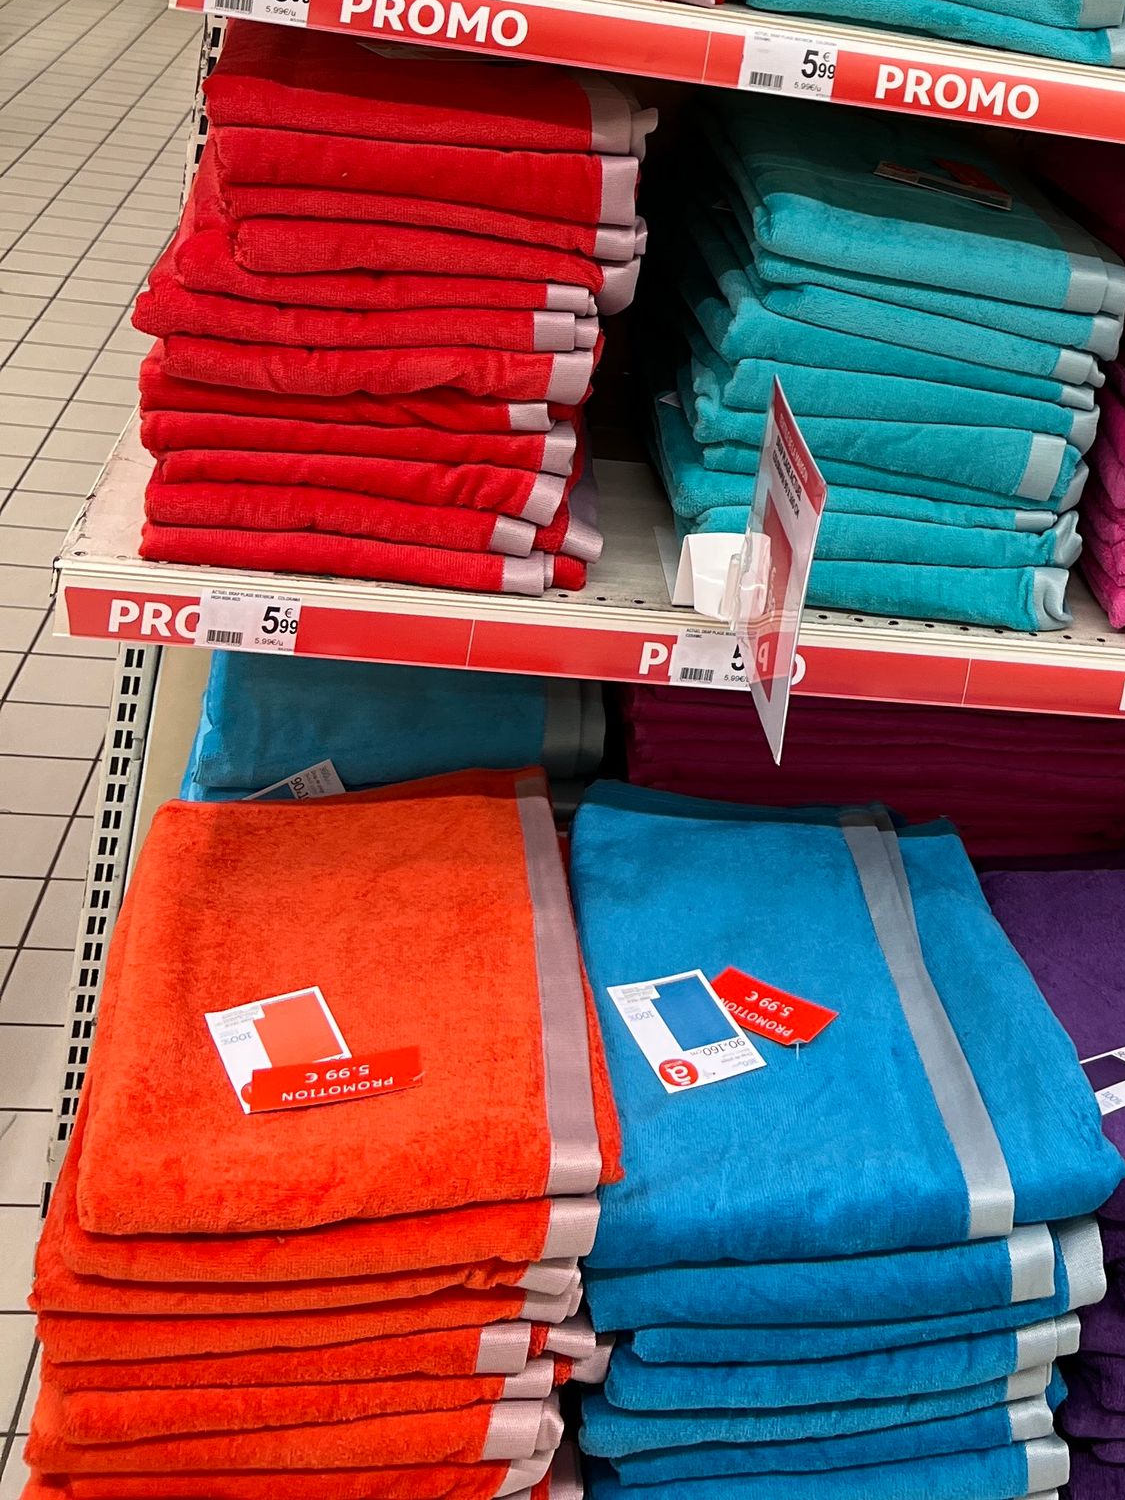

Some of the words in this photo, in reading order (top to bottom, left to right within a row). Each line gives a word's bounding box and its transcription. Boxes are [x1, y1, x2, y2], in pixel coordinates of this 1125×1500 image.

[874, 63, 1040, 120] PROMO
[108, 599, 200, 639] PRO
[759, 999, 794, 1018] 5.99
[281, 1076, 394, 1102] PROMOTION
